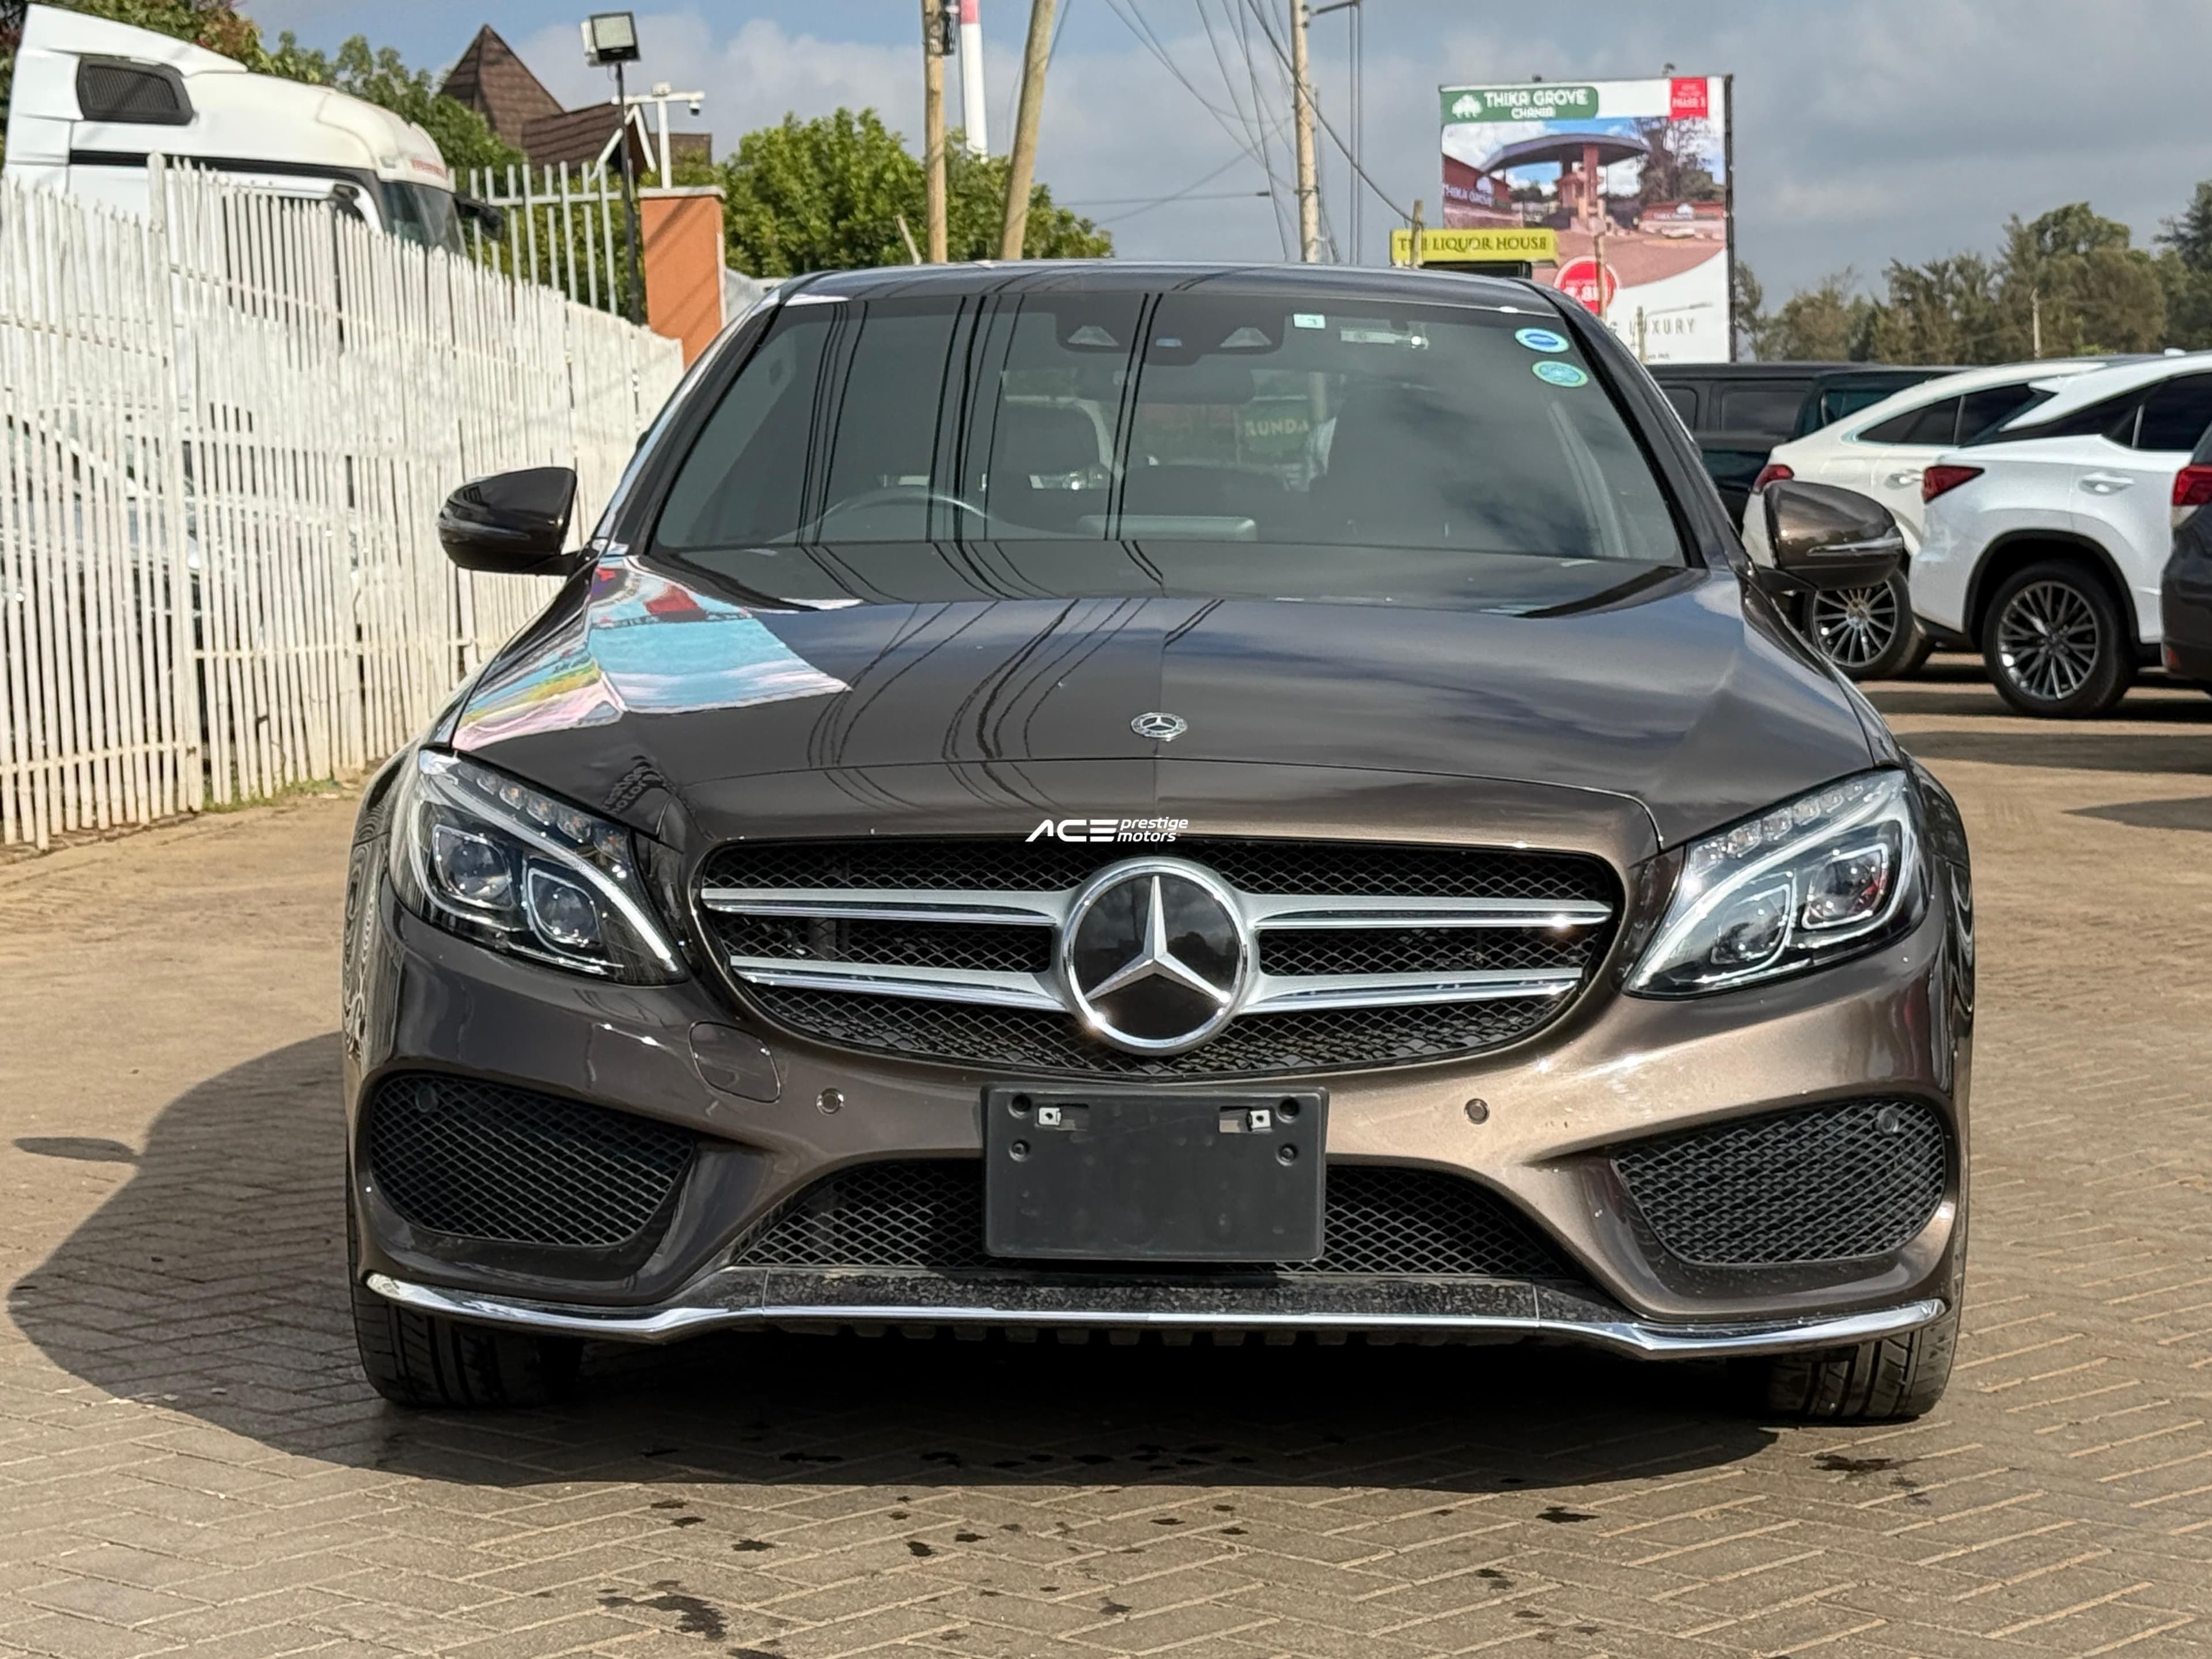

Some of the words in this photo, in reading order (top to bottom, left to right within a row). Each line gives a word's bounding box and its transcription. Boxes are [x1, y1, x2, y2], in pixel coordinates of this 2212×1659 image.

[1533, 88, 1588, 106] GROVE
[1433, 237, 1494, 253] LIQUOR
[1496, 237, 1547, 251] HOUSE
